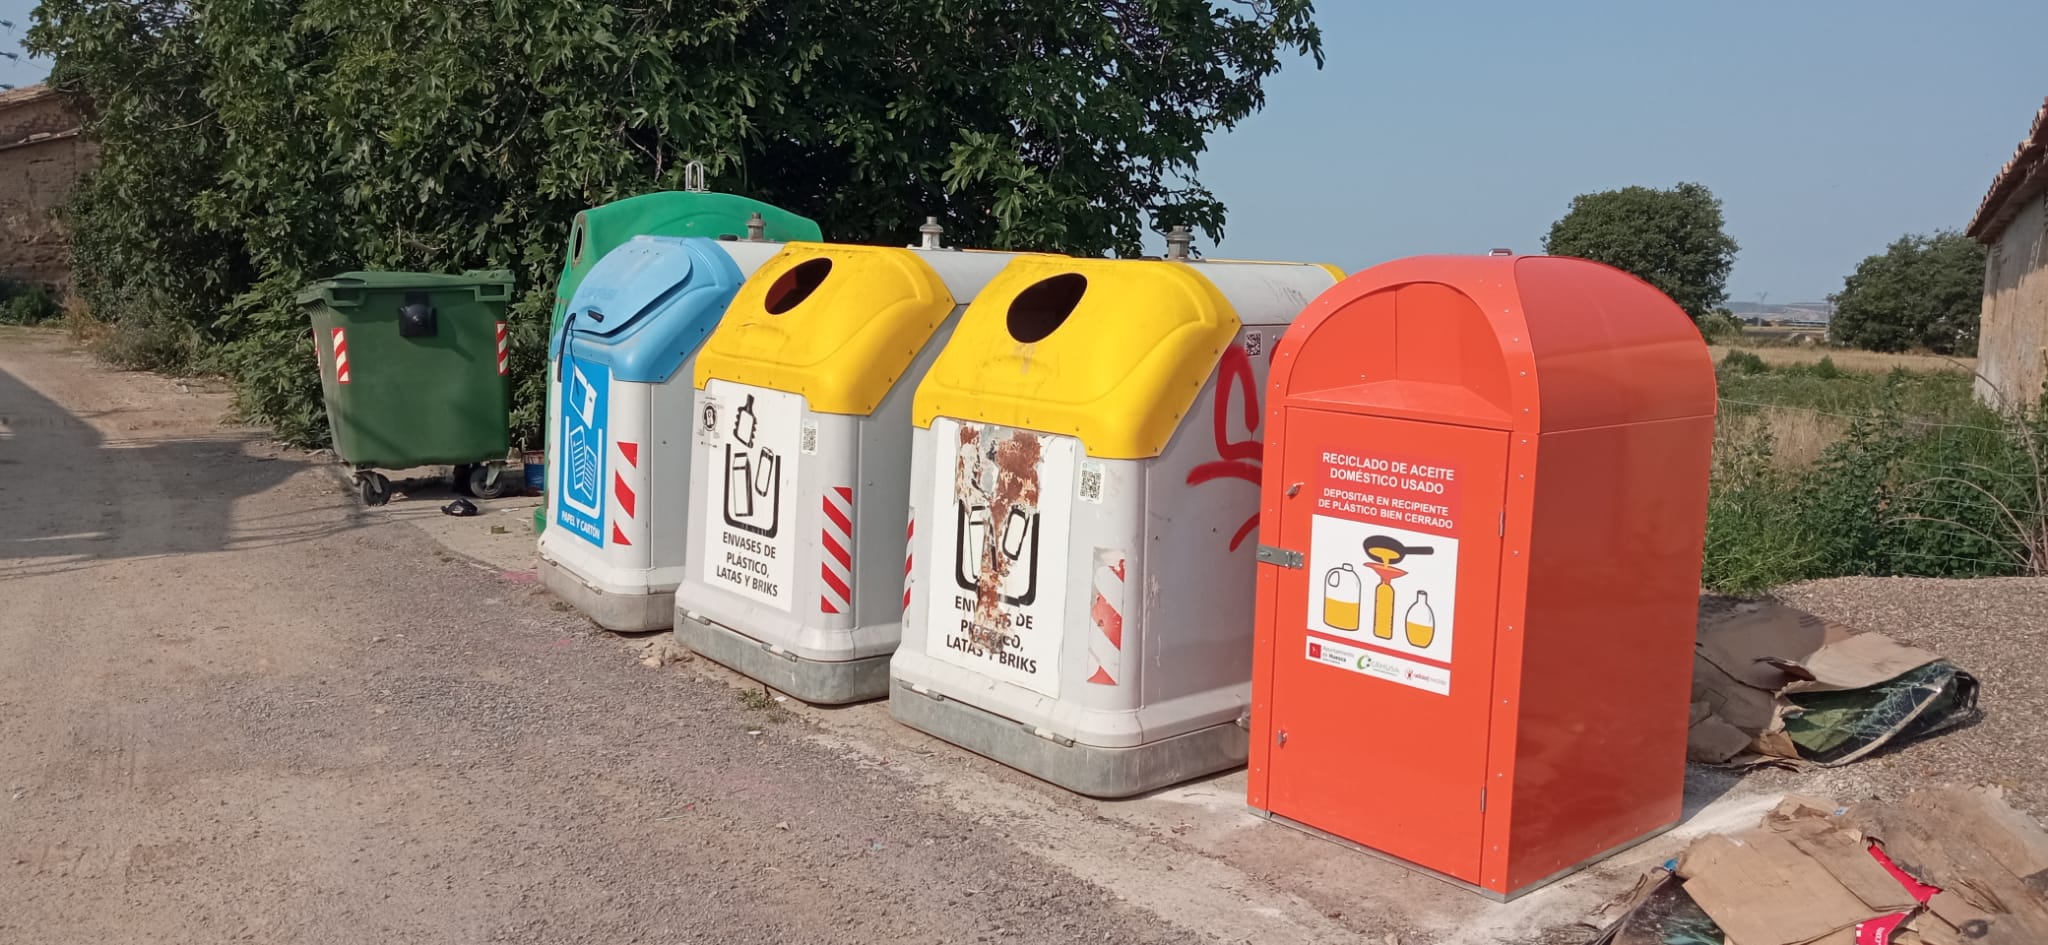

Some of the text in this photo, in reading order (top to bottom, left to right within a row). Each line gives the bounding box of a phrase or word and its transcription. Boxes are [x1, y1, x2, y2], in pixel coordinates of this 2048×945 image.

[1322, 452, 1455, 481] RECICLADO DE ACEITE
[1329, 468, 1444, 495] DOMÉSTICO USADO
[1318, 498, 1454, 529] DE PLÁSTICO BIEN CERRADO
[1323, 488, 1449, 516] DEPOSITAR EN RECIPIENTE
[561, 510, 601, 540] PAPEL Y CARTÓN
[722, 531, 777, 559] ENVASES DE
[726, 551, 770, 578] PLÁSTICO,
[716, 565, 778, 597] LATAS Y BRIKS
[1015, 613, 1034, 630] DE
[946, 634, 984, 657] LATAS
[999, 650, 1038, 674] BRIKS
